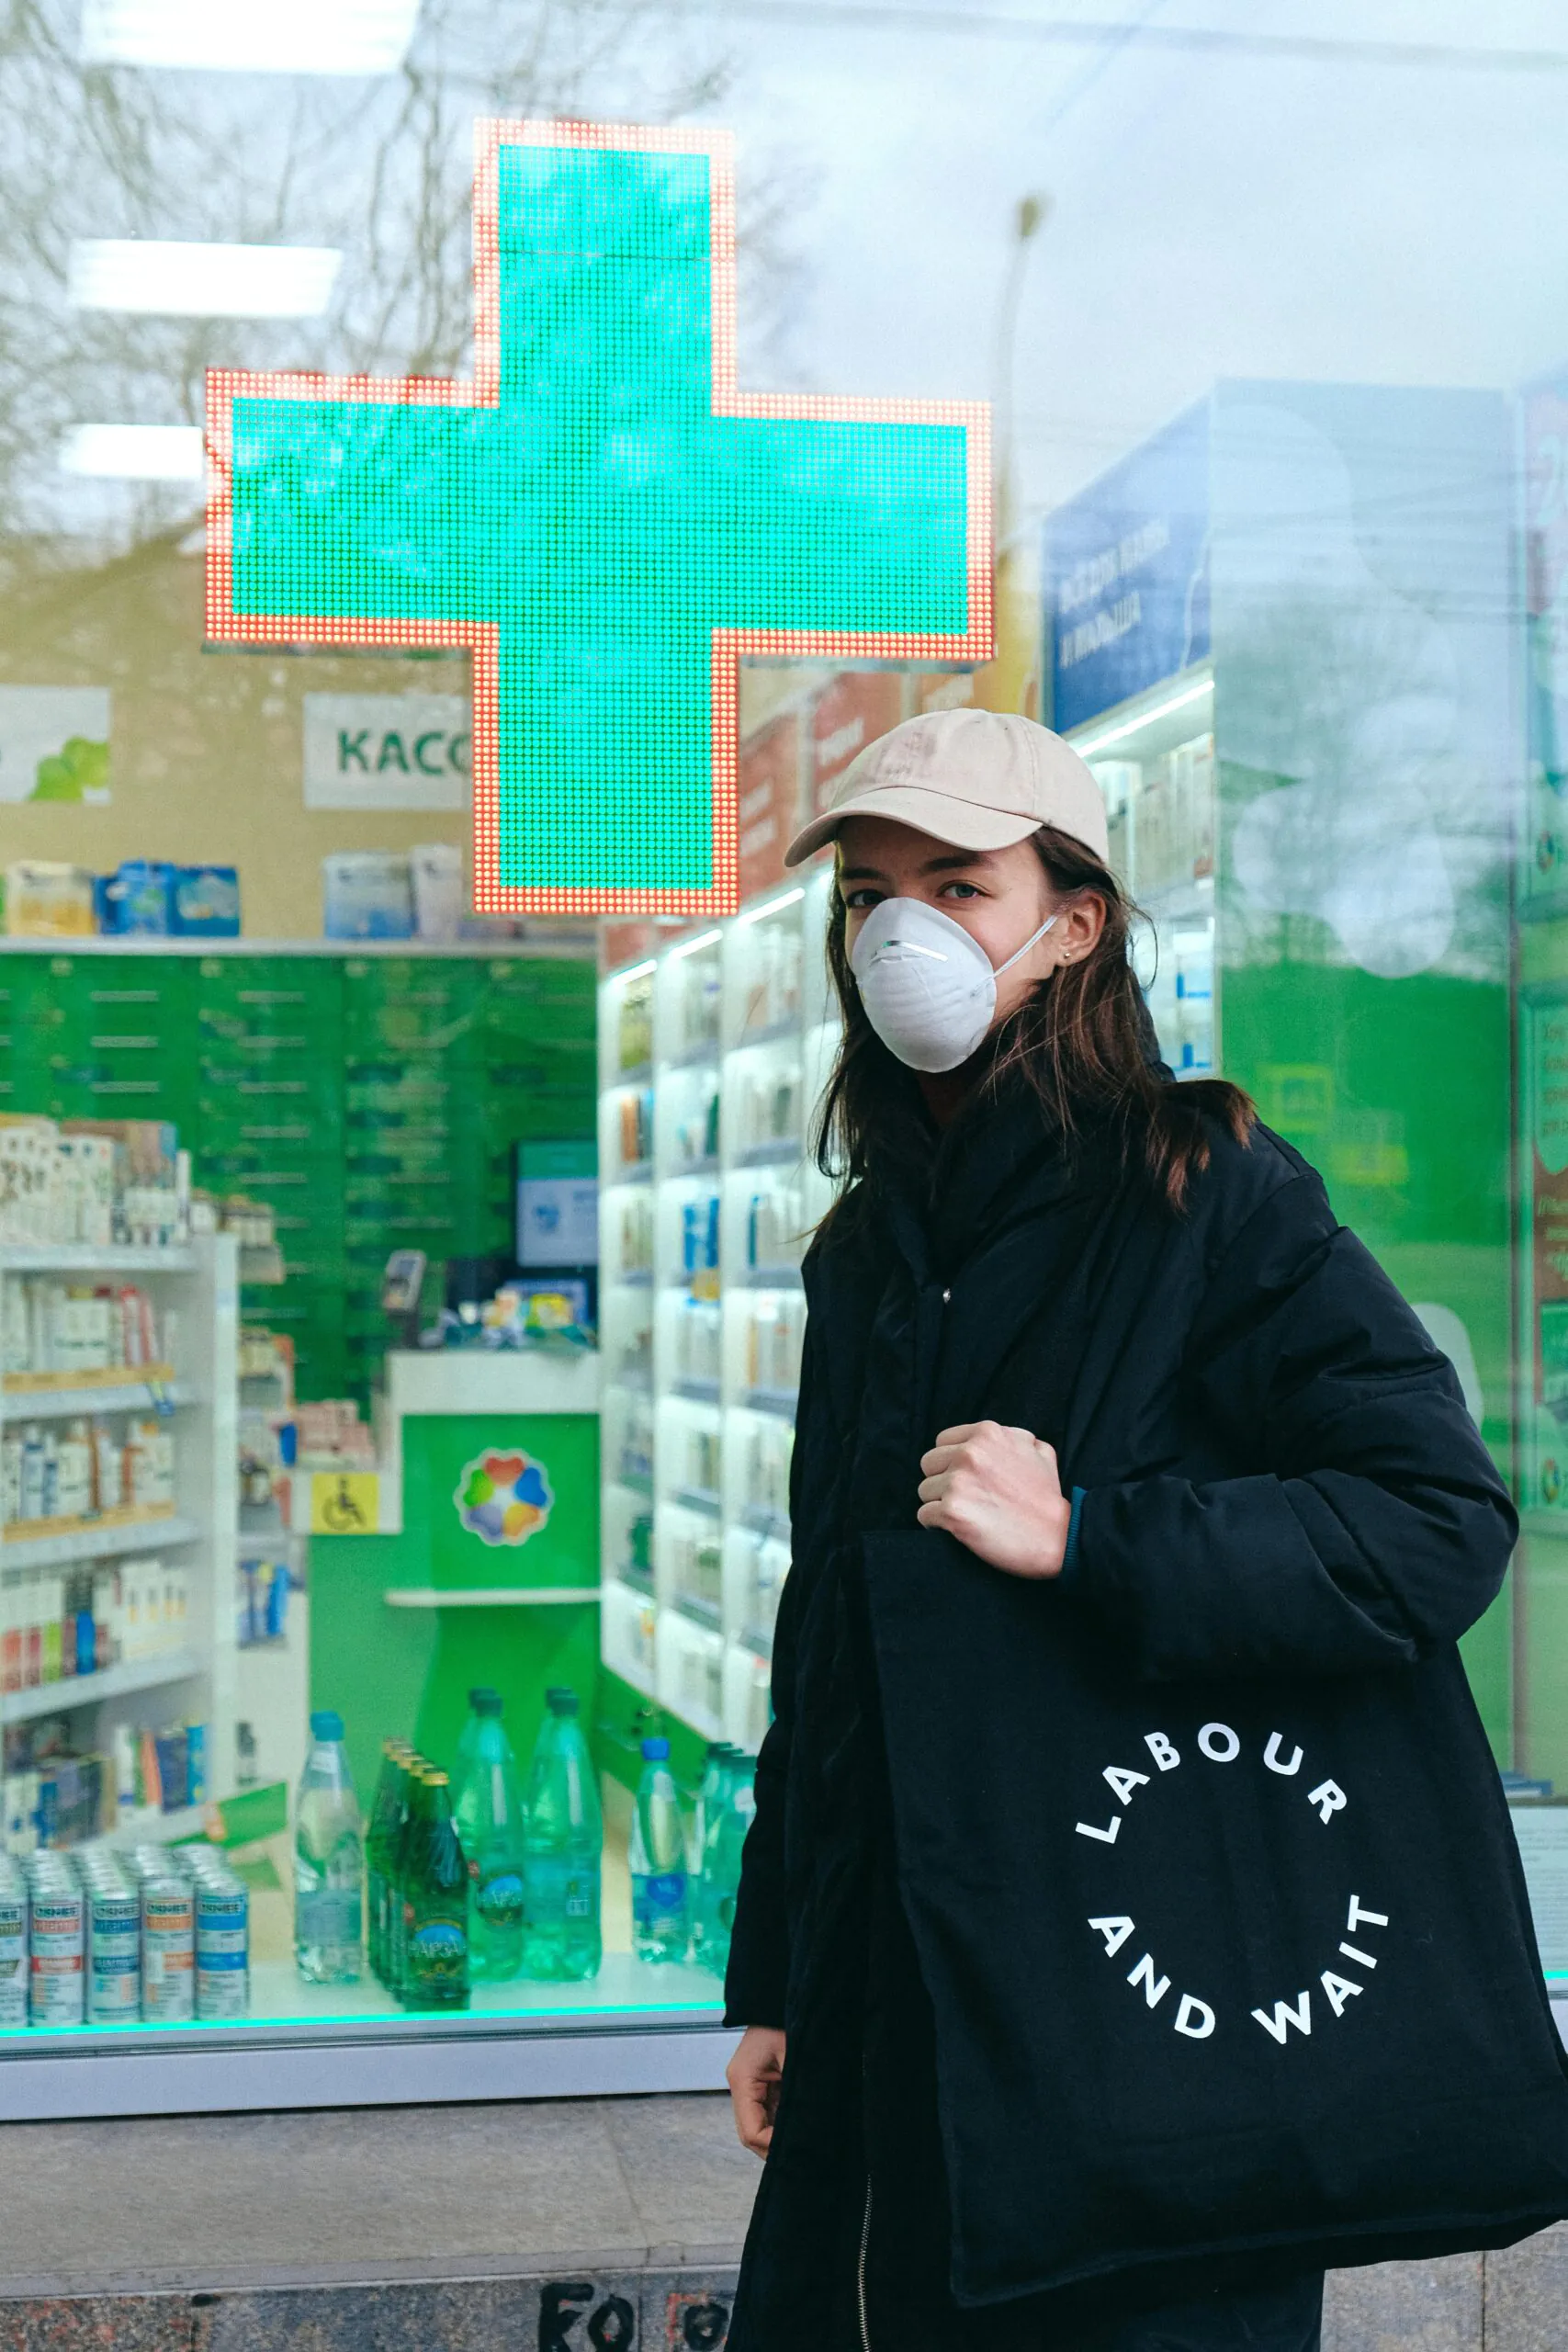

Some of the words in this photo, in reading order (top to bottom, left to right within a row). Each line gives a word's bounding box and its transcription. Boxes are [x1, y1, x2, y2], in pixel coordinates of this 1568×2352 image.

[1076, 1722, 1347, 1844] LABOUR
[1088, 1916, 1216, 2039] AND
[1251, 1894, 1389, 2044] WAIT
